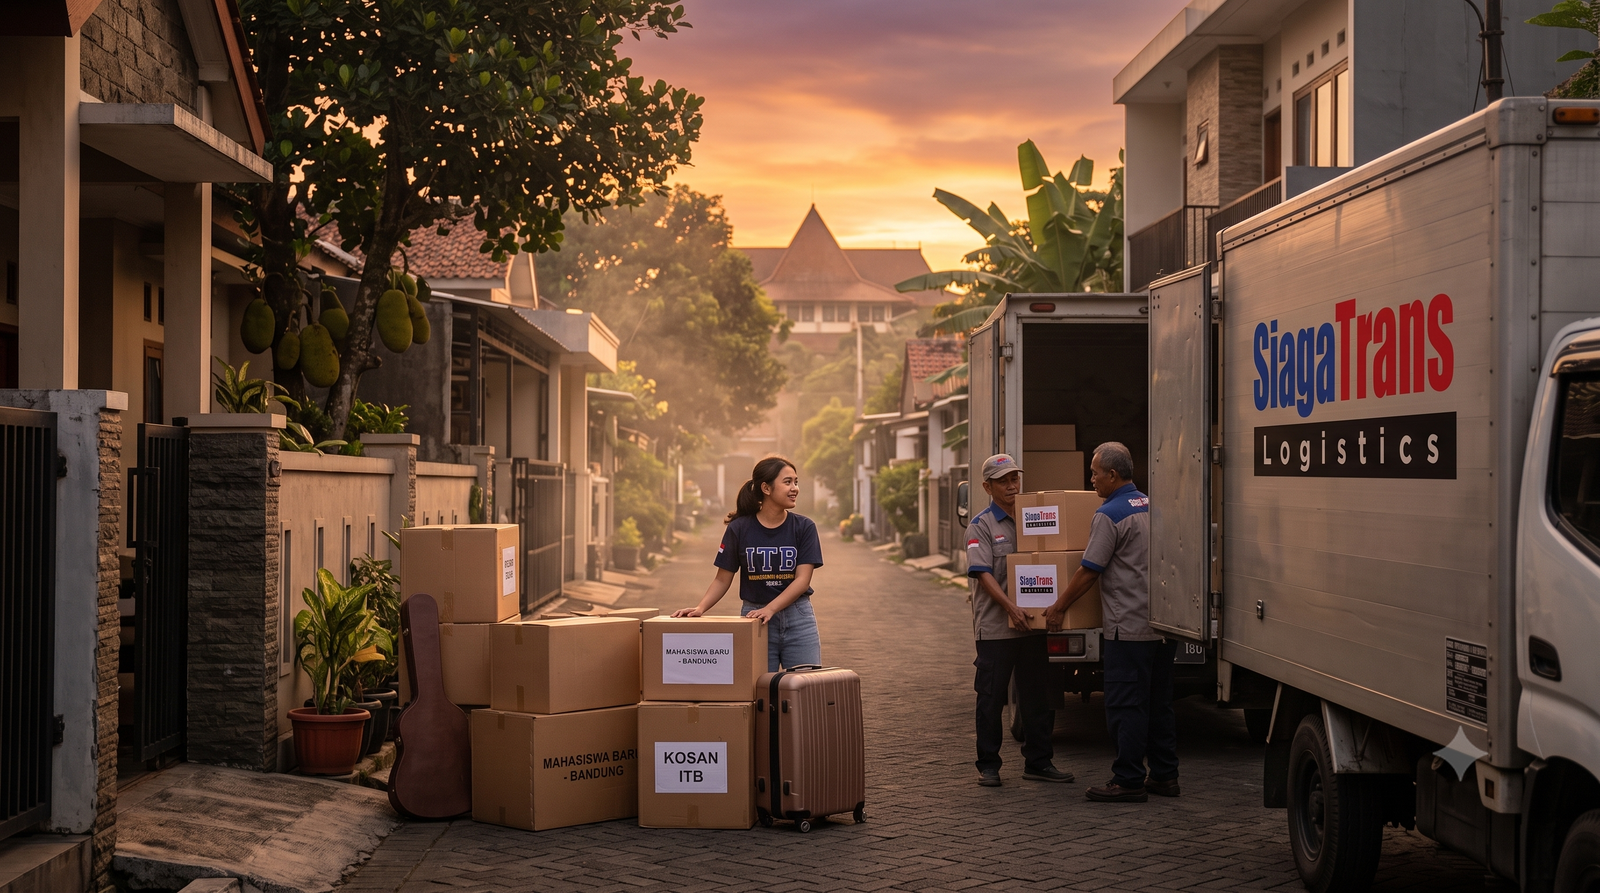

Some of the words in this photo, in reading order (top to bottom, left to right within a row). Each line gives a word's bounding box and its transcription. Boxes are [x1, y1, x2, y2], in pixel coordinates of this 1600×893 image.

[1254, 293, 1454, 418] SiagaTrans
[1263, 427, 1439, 472] Logistics
[746, 546, 798, 572] ITB
[543, 752, 610, 769] MAHASISWA
[664, 751, 718, 764] KOSAN
[570, 765, 624, 781] BANDUNG
[679, 770, 704, 783] ITB
